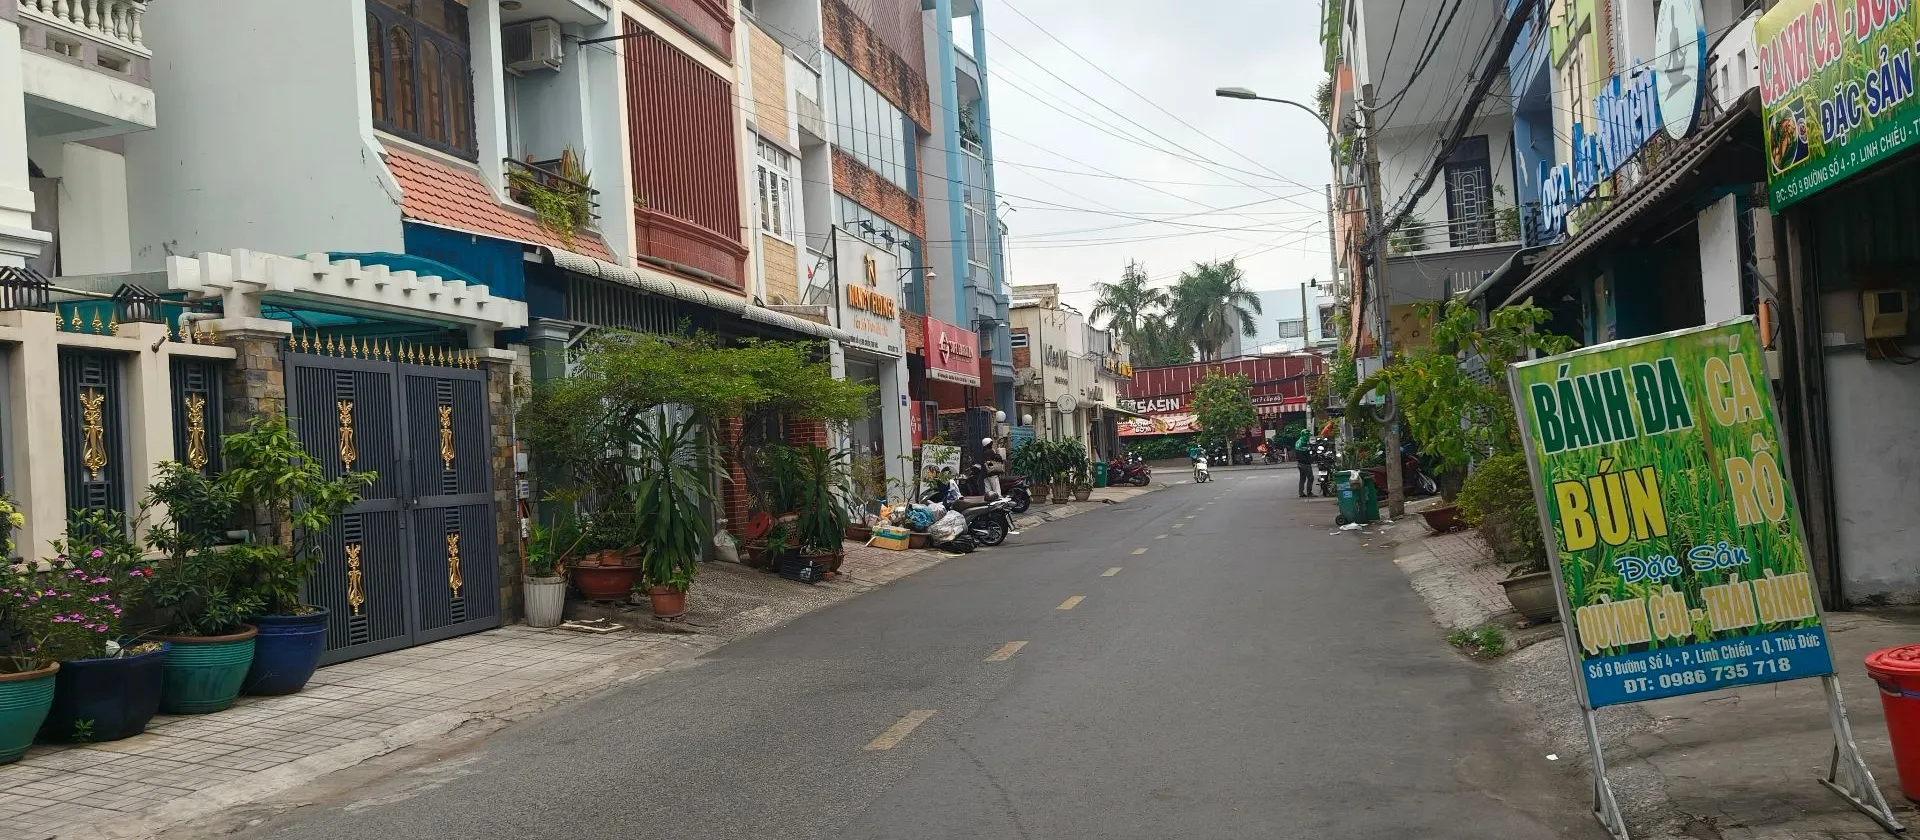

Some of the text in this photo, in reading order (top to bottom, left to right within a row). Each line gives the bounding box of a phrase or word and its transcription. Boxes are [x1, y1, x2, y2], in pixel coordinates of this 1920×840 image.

[1759, 13, 1811, 108] CANH
[1820, 44, 1913, 146] ĐẶC SẢN
[1788, 177, 1797, 198] SỐ
[1798, 180, 1804, 193] 9
[1803, 166, 1828, 190] ĐƯỜNG
[1828, 154, 1840, 179] SỐ
[1840, 158, 1846, 170] 4
[1851, 152, 1859, 167] P.
[1860, 142, 1879, 164] LINH
[1880, 121, 1907, 152] CHIỂU
[1137, 398, 1180, 413] SASIN
[1530, 357, 1695, 455] BÁNH ĐA
[1704, 334, 1763, 426] CÁ
[1553, 457, 1669, 552] BÚN
[1726, 433, 1785, 526] RÔ
[1614, 542, 1750, 584] Đặc Sản
[1576, 594, 1651, 656] QUỲNH
[1650, 584, 1692, 640] CÔI
[1701, 573, 1757, 632] THÁI
[1753, 568, 1816, 625] BÌNH
[1589, 661, 1602, 679] Số
[1604, 663, 1612, 677] 9
[1614, 657, 1647, 676] Đường
[1649, 653, 1663, 670] Số
[1665, 654, 1673, 667] 4
[1682, 651, 1694, 665] P.
[1696, 647, 1719, 664] Linh
[1720, 640, 1753, 659] Chiểu
[1762, 640, 1775, 655] Q.
[1775, 633, 1796, 651] Thủ
[1797, 632, 1820, 649] Đức
[1623, 657, 1791, 694] ĐT: 0986 735 718
